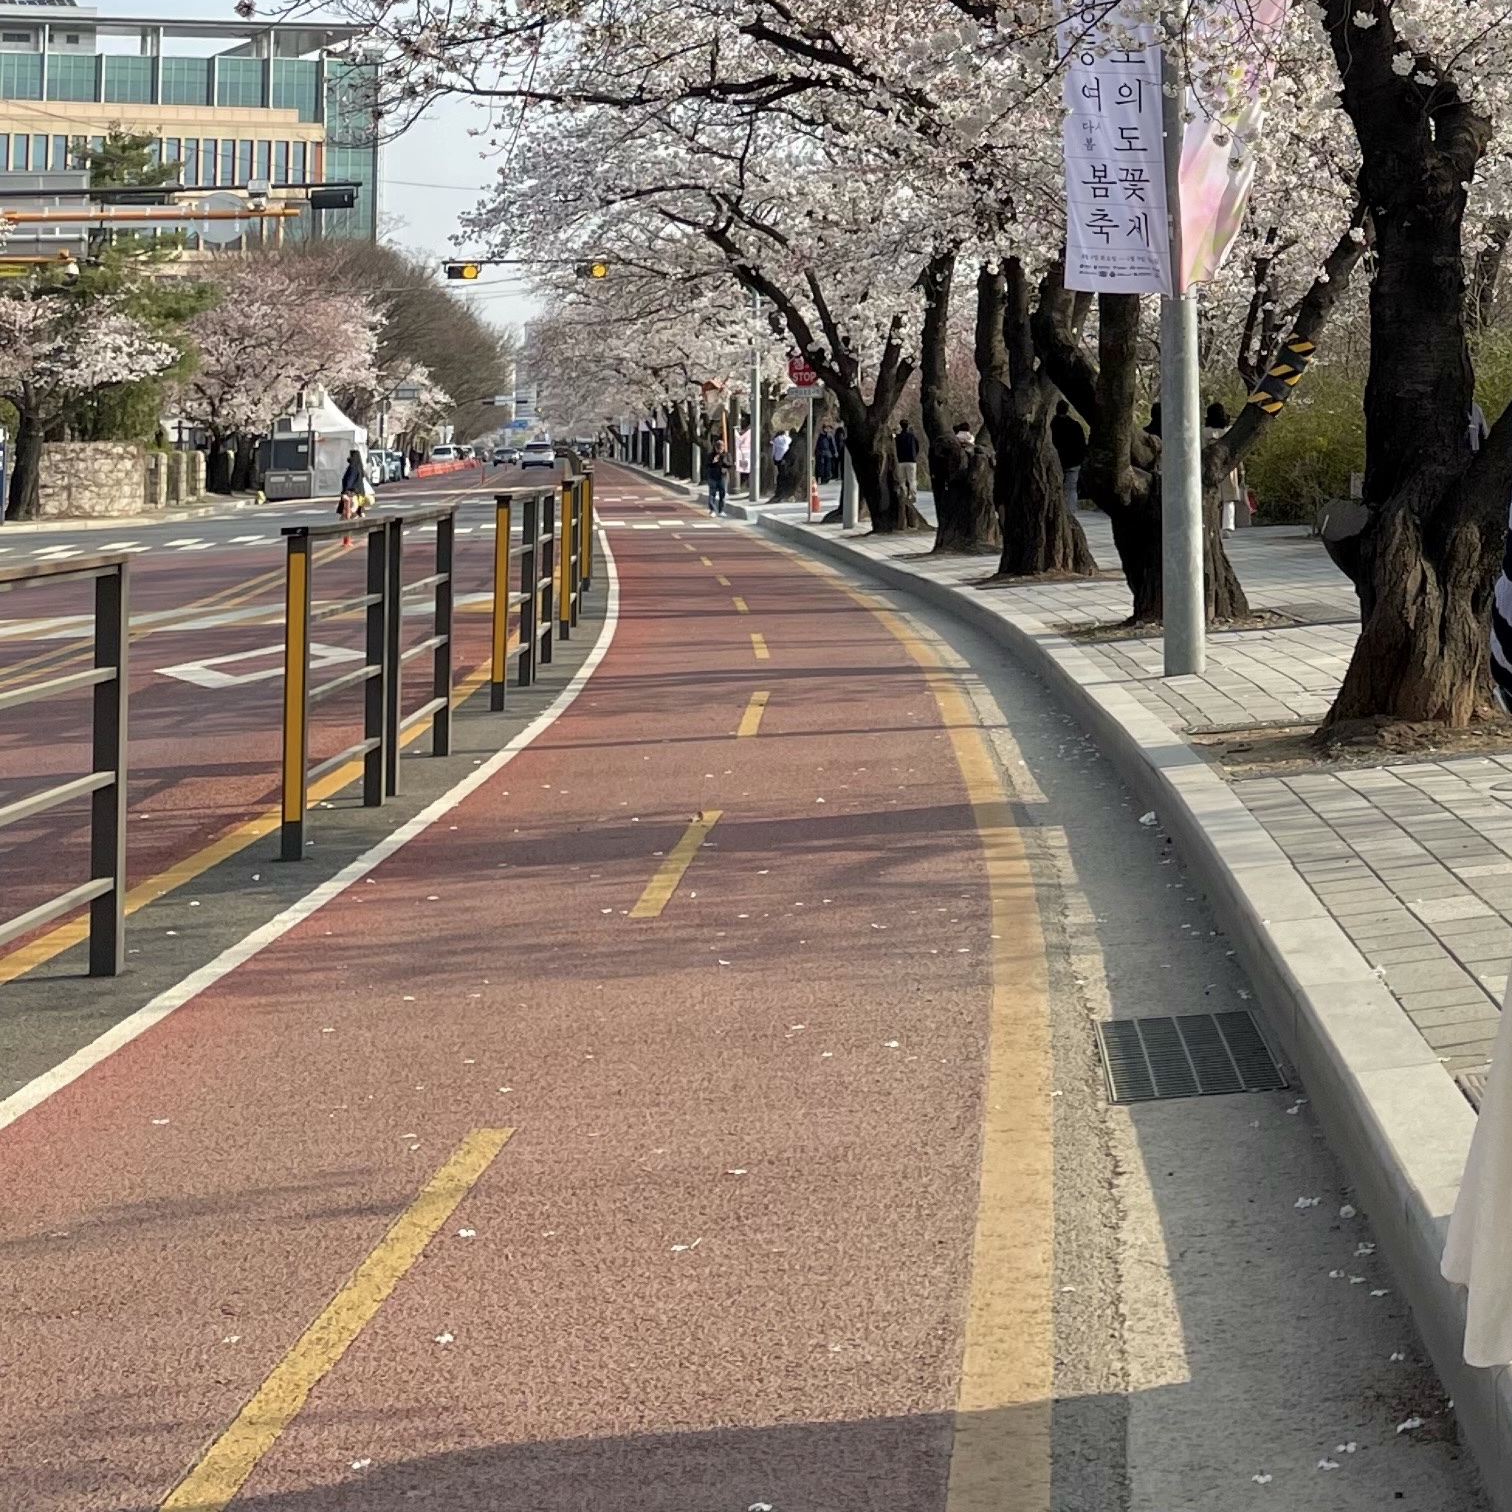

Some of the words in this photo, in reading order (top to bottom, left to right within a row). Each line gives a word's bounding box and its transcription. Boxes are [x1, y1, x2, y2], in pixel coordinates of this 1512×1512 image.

[1081, 163, 1151, 202] 봄꽃
[1085, 208, 1150, 248] 축제
[792, 371, 817, 382] STOP
